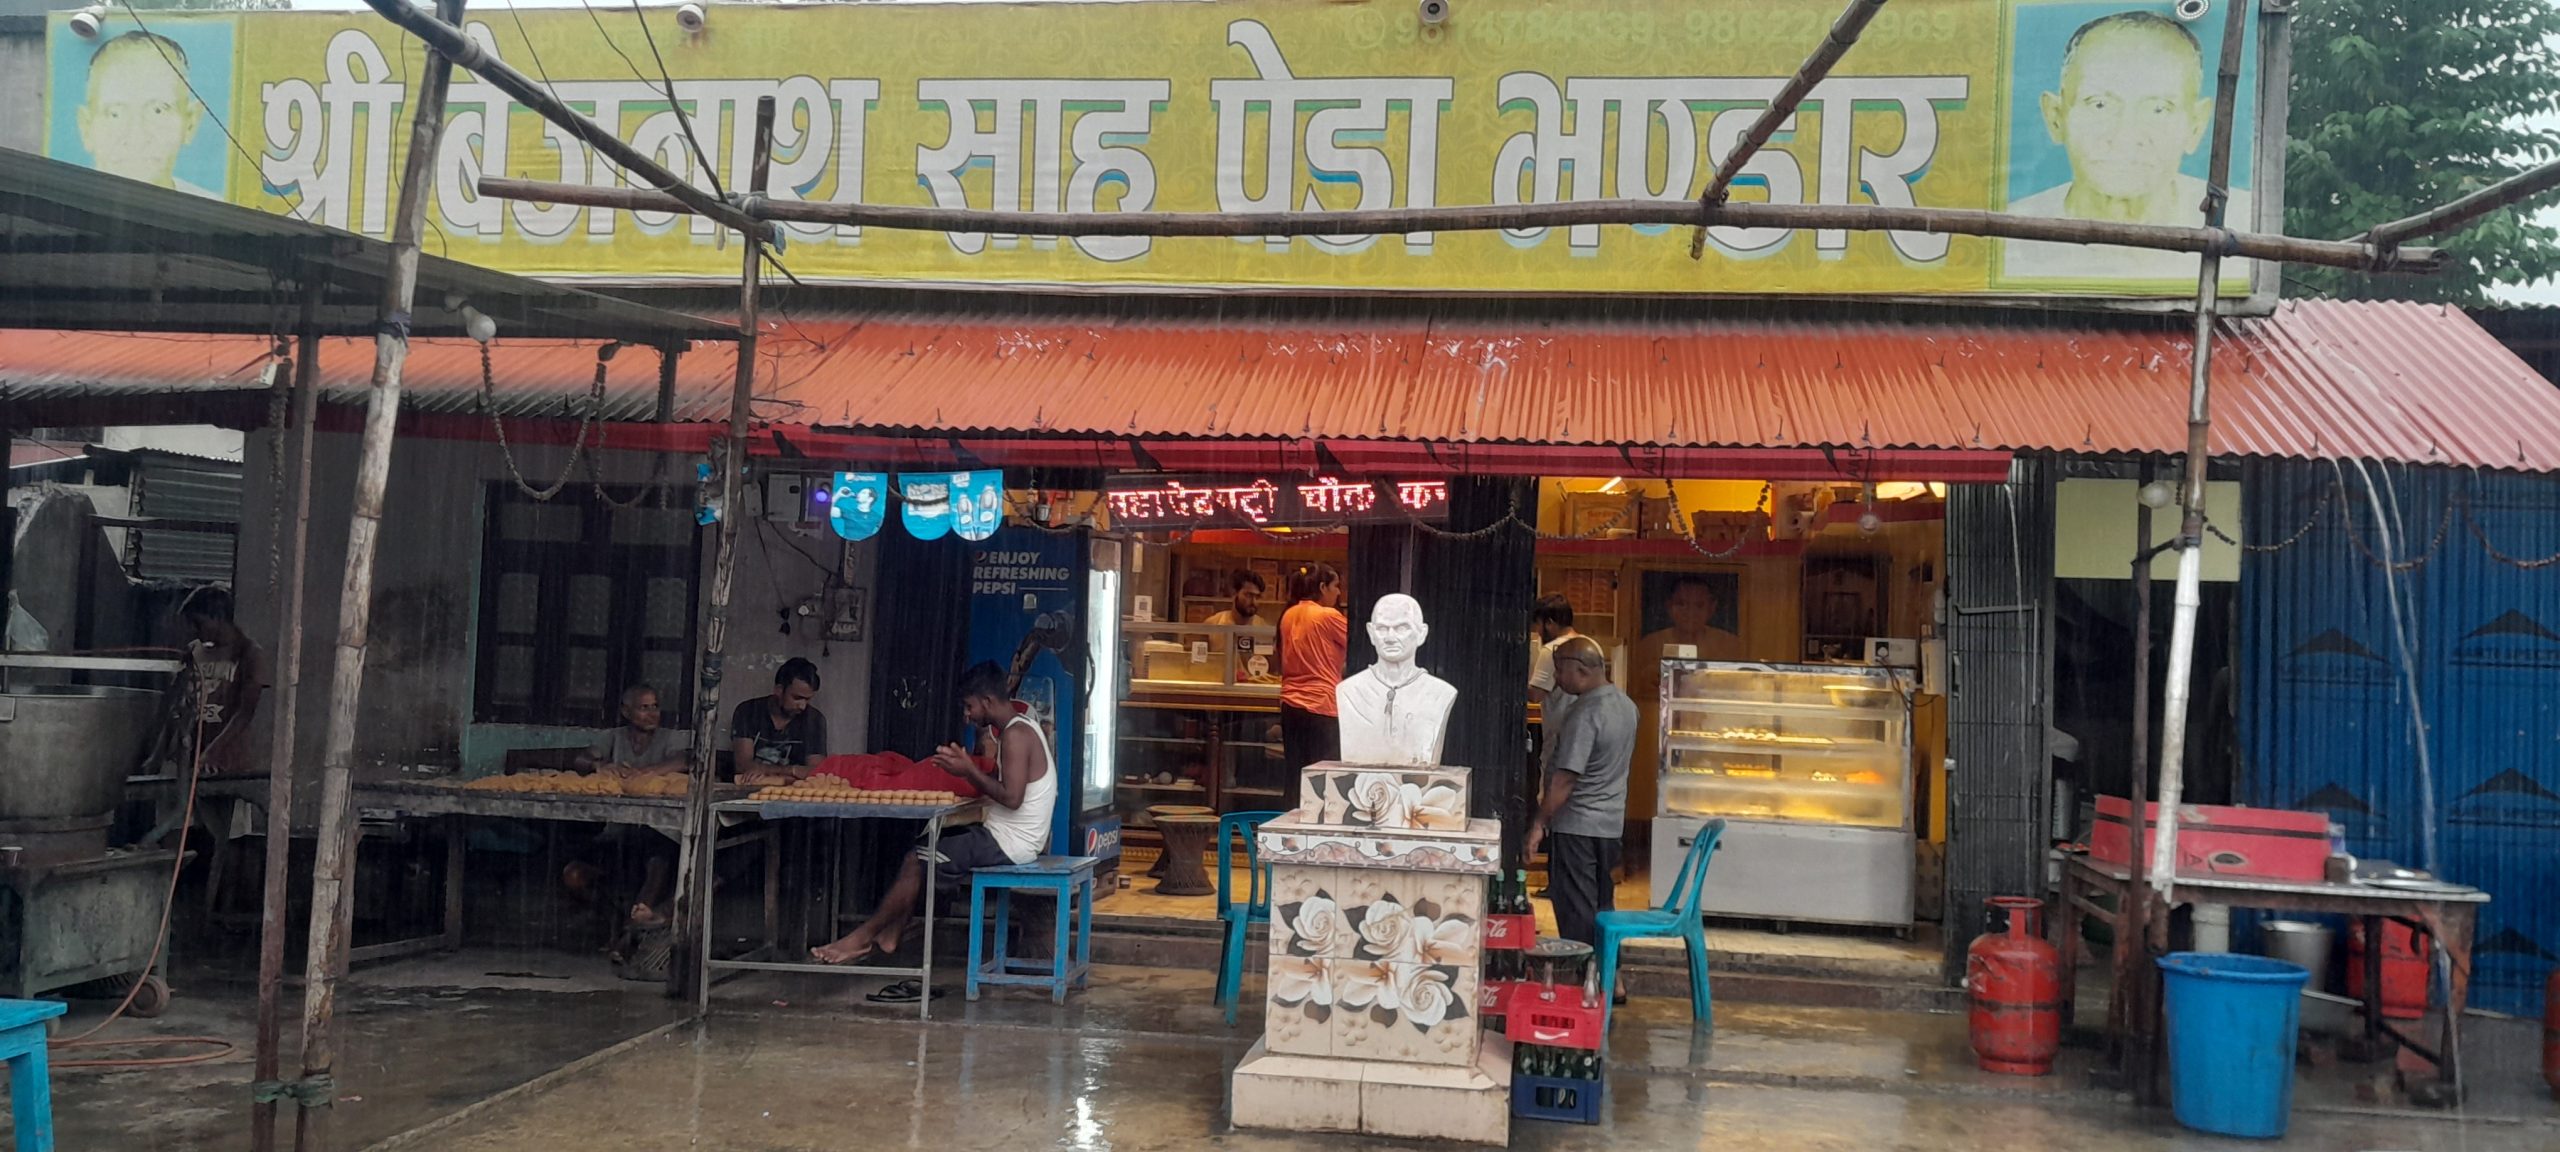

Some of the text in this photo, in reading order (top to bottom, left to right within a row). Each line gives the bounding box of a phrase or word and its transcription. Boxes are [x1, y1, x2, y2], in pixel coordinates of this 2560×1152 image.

[261, 28, 405, 234] श्री
[916, 78, 1172, 262] साह
[1491, 70, 1969, 262] भण्डार
[1297, 476, 1376, 513] चौक
[989, 551, 1041, 564] ENJOY
[973, 566, 1070, 580] REFRESHING
[972, 581, 1016, 595] PEPSI
[1097, 825, 1119, 854] pepsi
